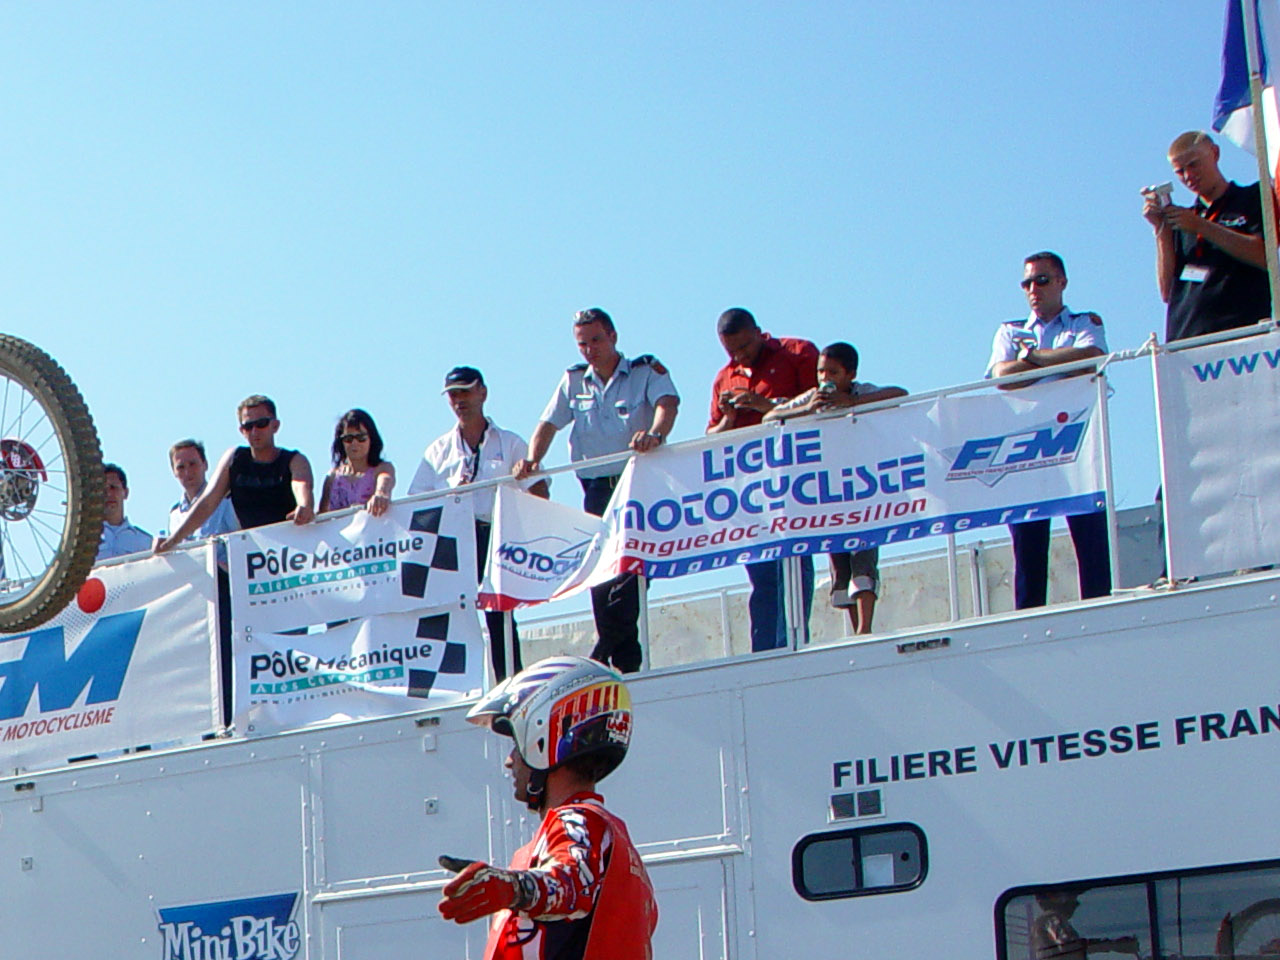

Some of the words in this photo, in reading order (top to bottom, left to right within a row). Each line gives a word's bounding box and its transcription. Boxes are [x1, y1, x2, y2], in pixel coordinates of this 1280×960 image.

[950, 420, 1087, 472] FFM
[246, 546, 308, 579] Pôle
[311, 536, 424, 569] Mécanique
[251, 649, 311, 680] Pôle
[314, 643, 433, 671] Mécanique
[3, 707, 116, 742] MOTOCYCLISME
[832, 746, 977, 788] FILIERE
[989, 722, 1161, 769] VITESSE
